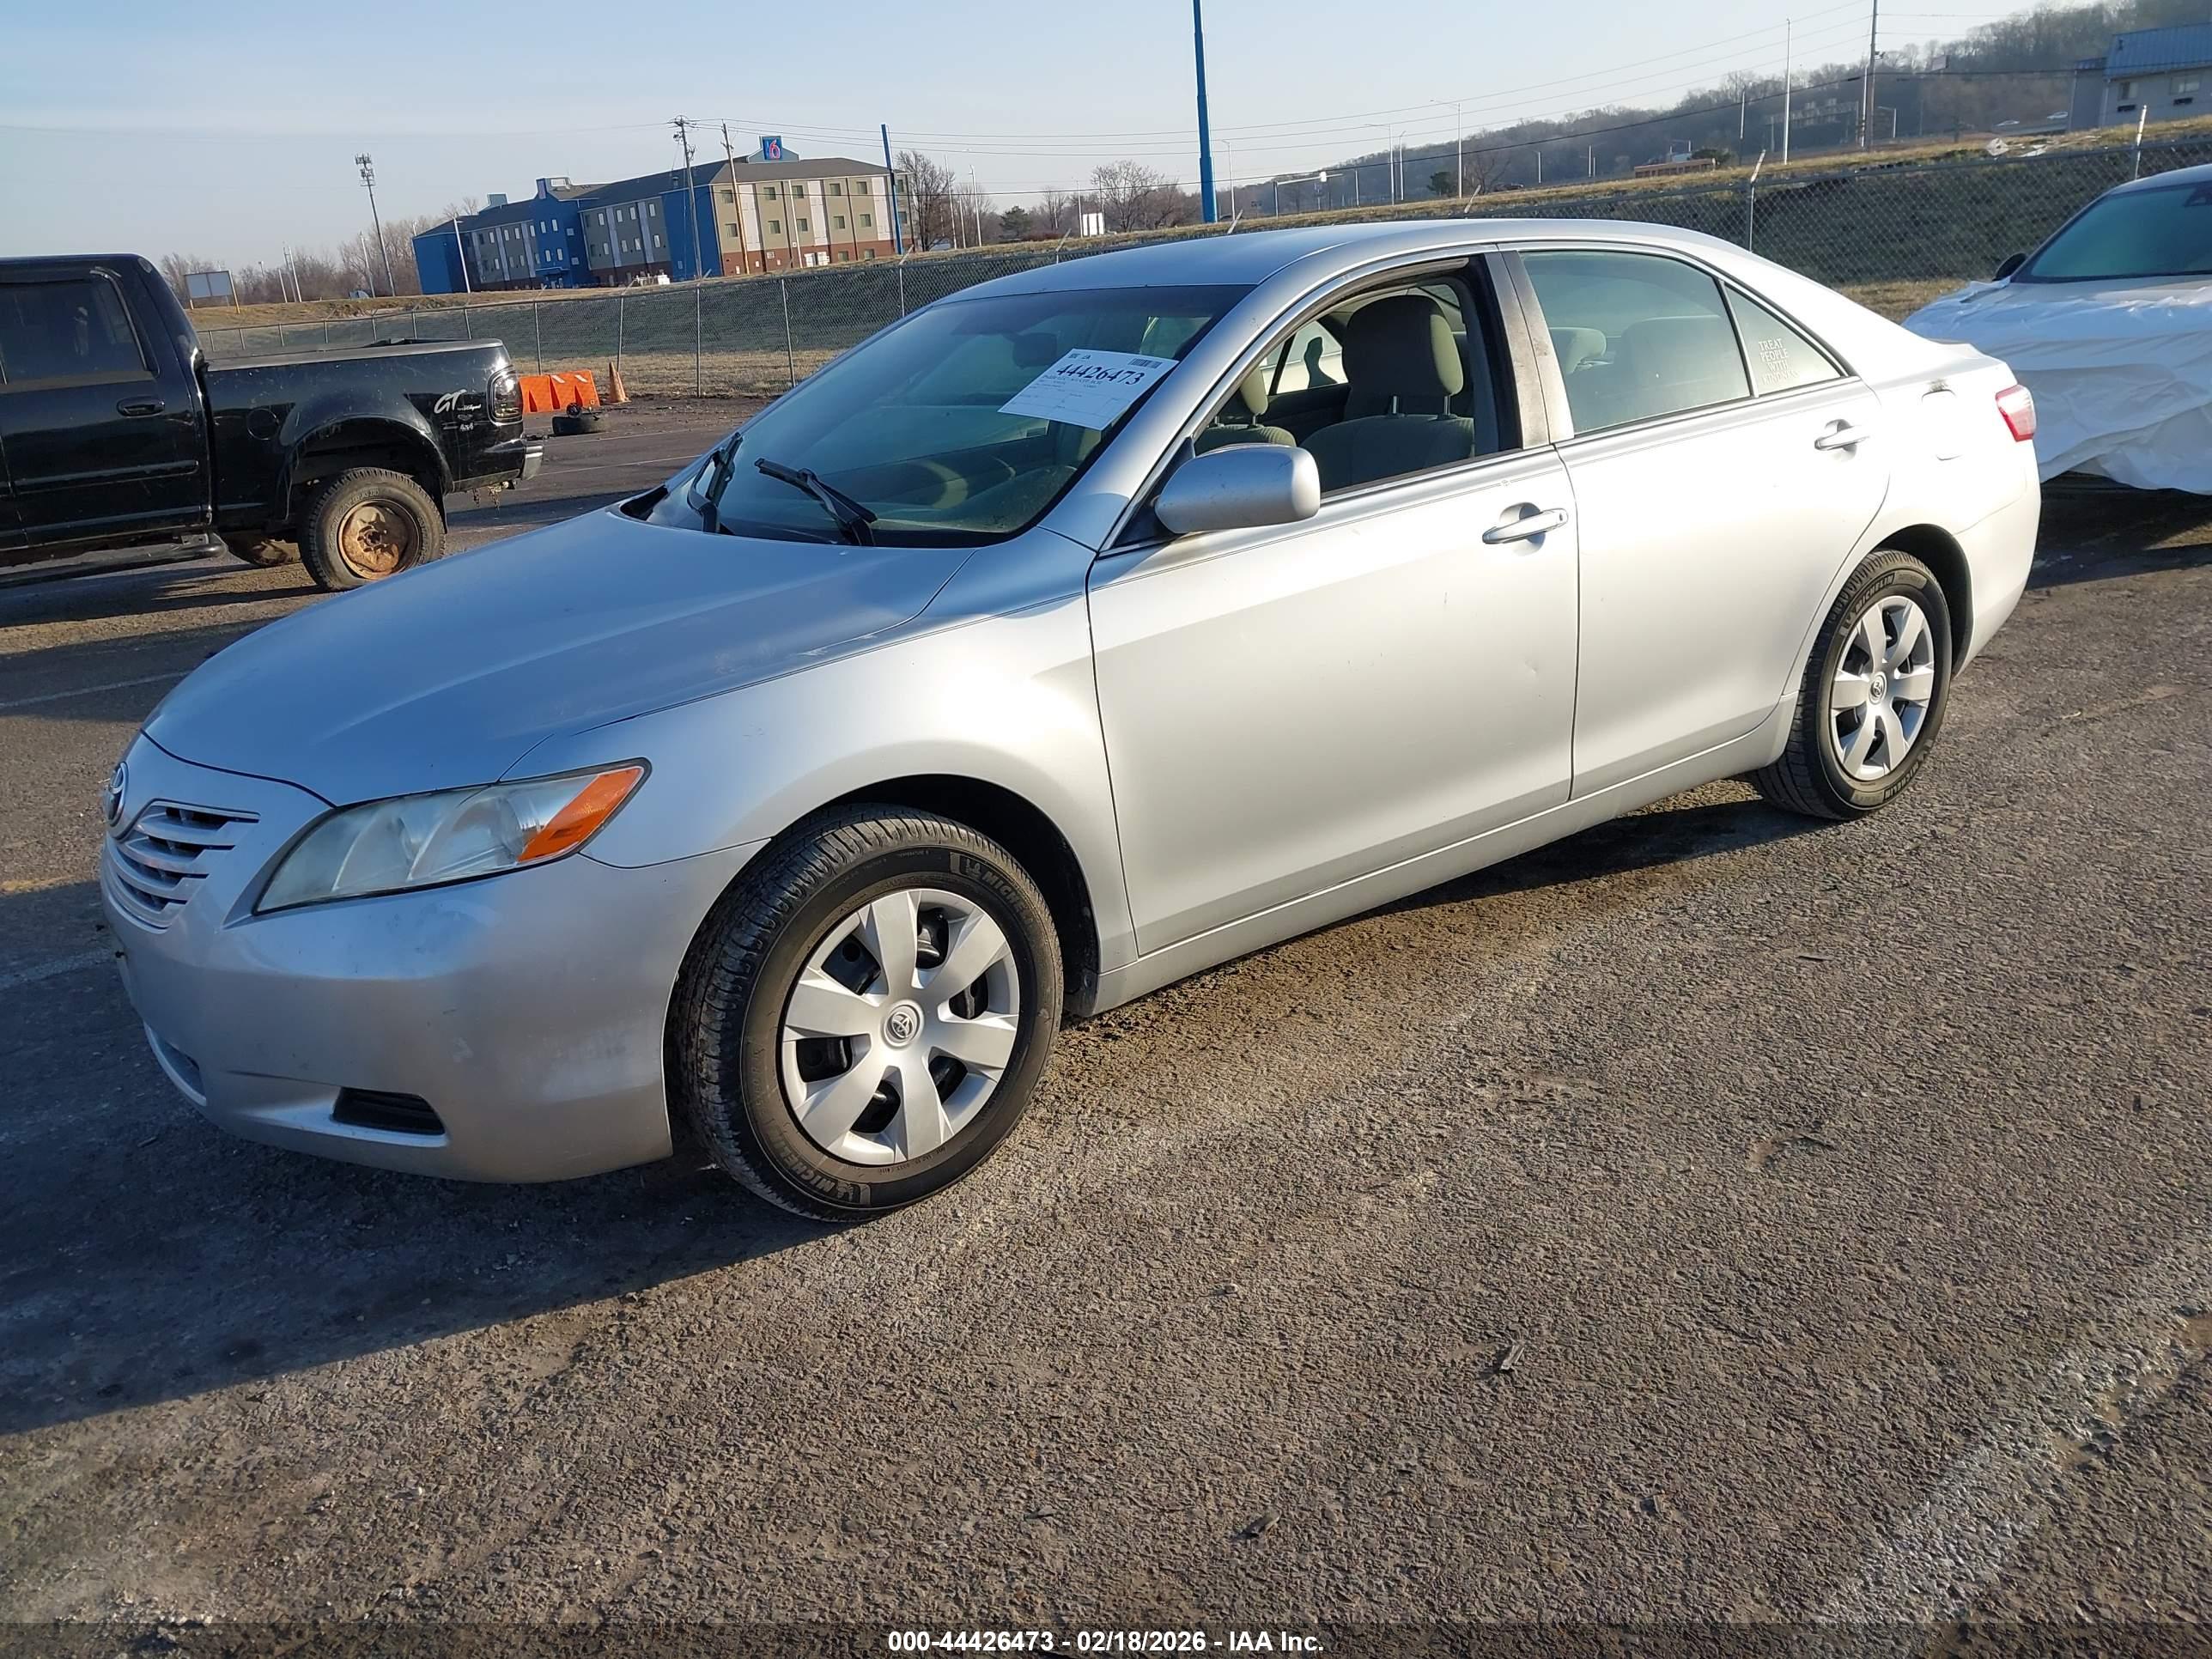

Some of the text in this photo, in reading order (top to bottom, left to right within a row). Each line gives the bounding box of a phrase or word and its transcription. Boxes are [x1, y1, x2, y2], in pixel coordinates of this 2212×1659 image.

[1758, 338, 1783, 351] TREAT
[1760, 349, 1789, 362] PEOPLE
[1767, 360, 1788, 372] WITH
[1056, 363, 1146, 386] 44426473
[1856, 573, 1895, 615] MICHELIN
